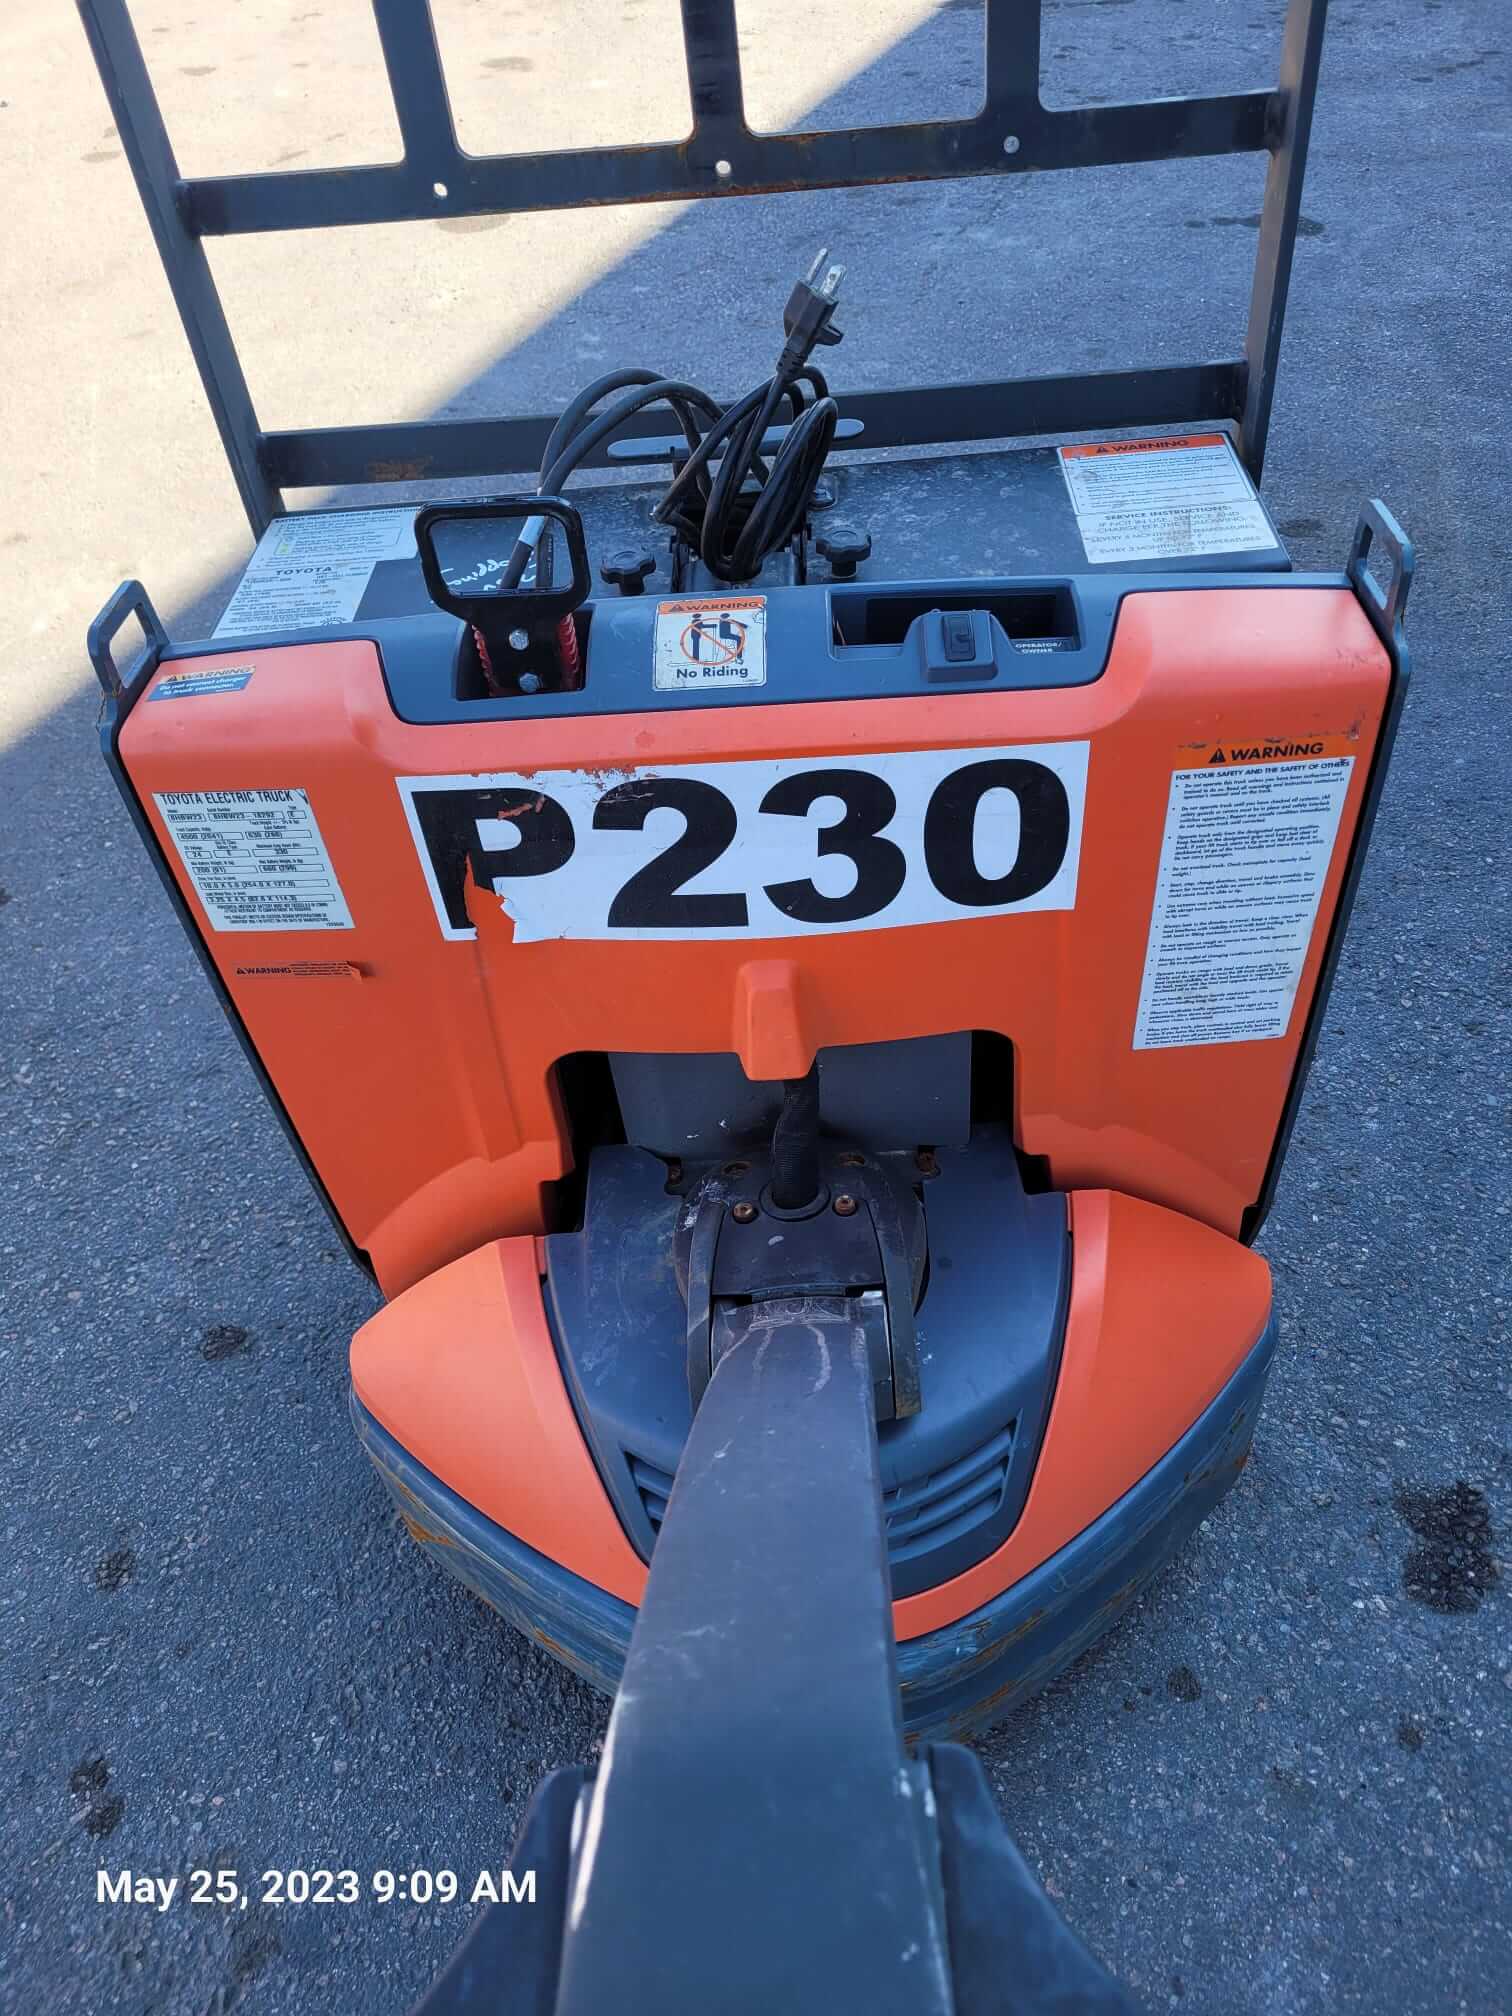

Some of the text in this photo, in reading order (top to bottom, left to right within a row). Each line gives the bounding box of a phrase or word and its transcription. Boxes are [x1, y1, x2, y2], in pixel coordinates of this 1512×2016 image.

[1112, 440, 1189, 452] WARNING
[275, 566, 332, 576] TOYOTA
[686, 601, 759, 611] WARNING
[677, 665, 748, 679] No Riding
[1231, 742, 1324, 761] WARNING
[1280, 764, 1307, 772] SAFETY
[161, 790, 294, 805] TOYOTA ELECTRIC TRUCK
[411, 758, 1071, 929] P230
[246, 966, 291, 975] WARNING
